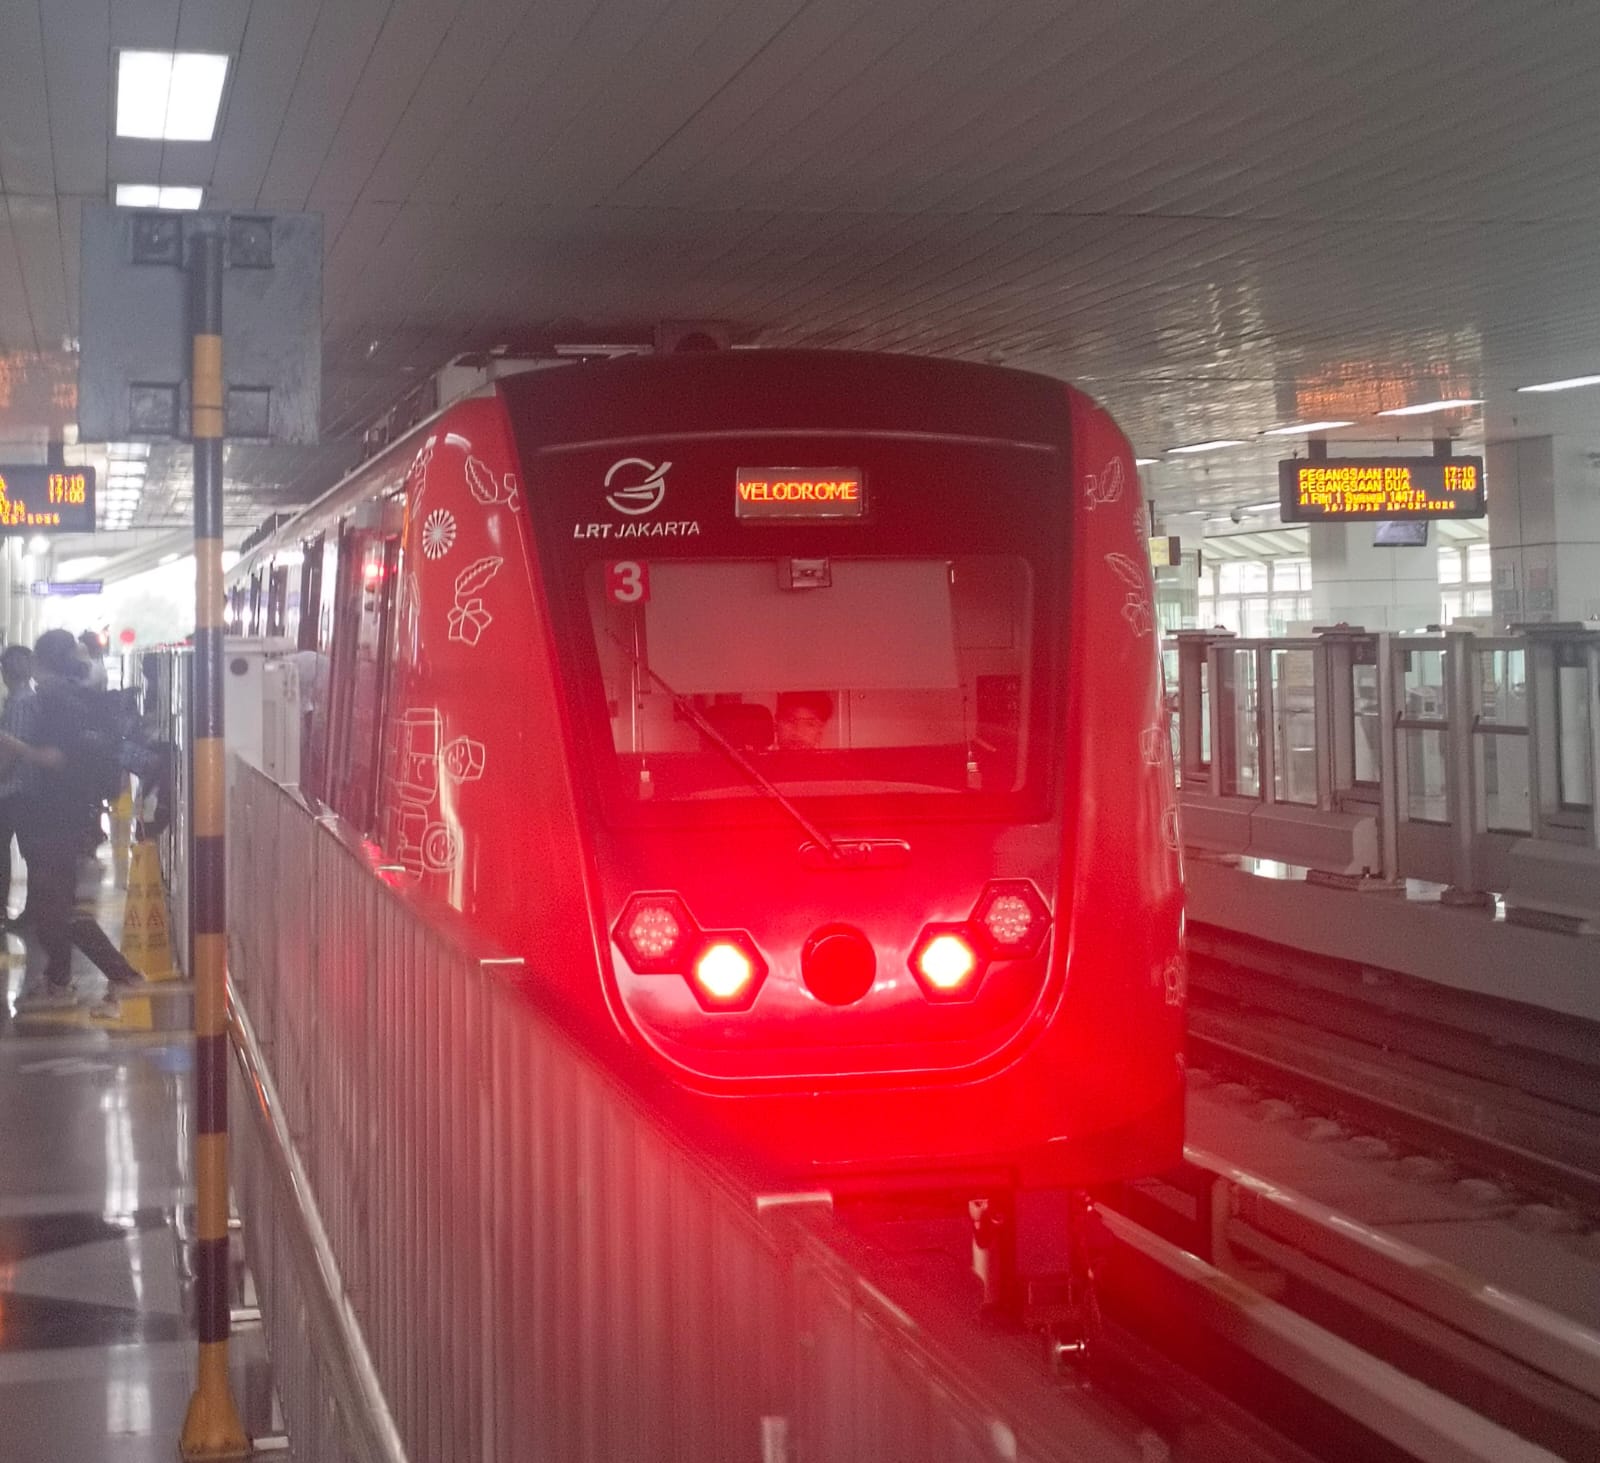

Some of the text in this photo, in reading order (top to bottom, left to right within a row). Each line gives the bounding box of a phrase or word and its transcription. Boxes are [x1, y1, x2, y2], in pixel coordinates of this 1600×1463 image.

[1299, 465, 1476, 481] PEGANGSAAN DUA 17:10
[739, 481, 858, 501] VELODROME
[1299, 478, 1477, 493] PEGANGSAAN DUA 17:00
[1416, 489, 1426, 502] H
[573, 521, 700, 539] LRT JAKARTA
[613, 560, 643, 603] 3
